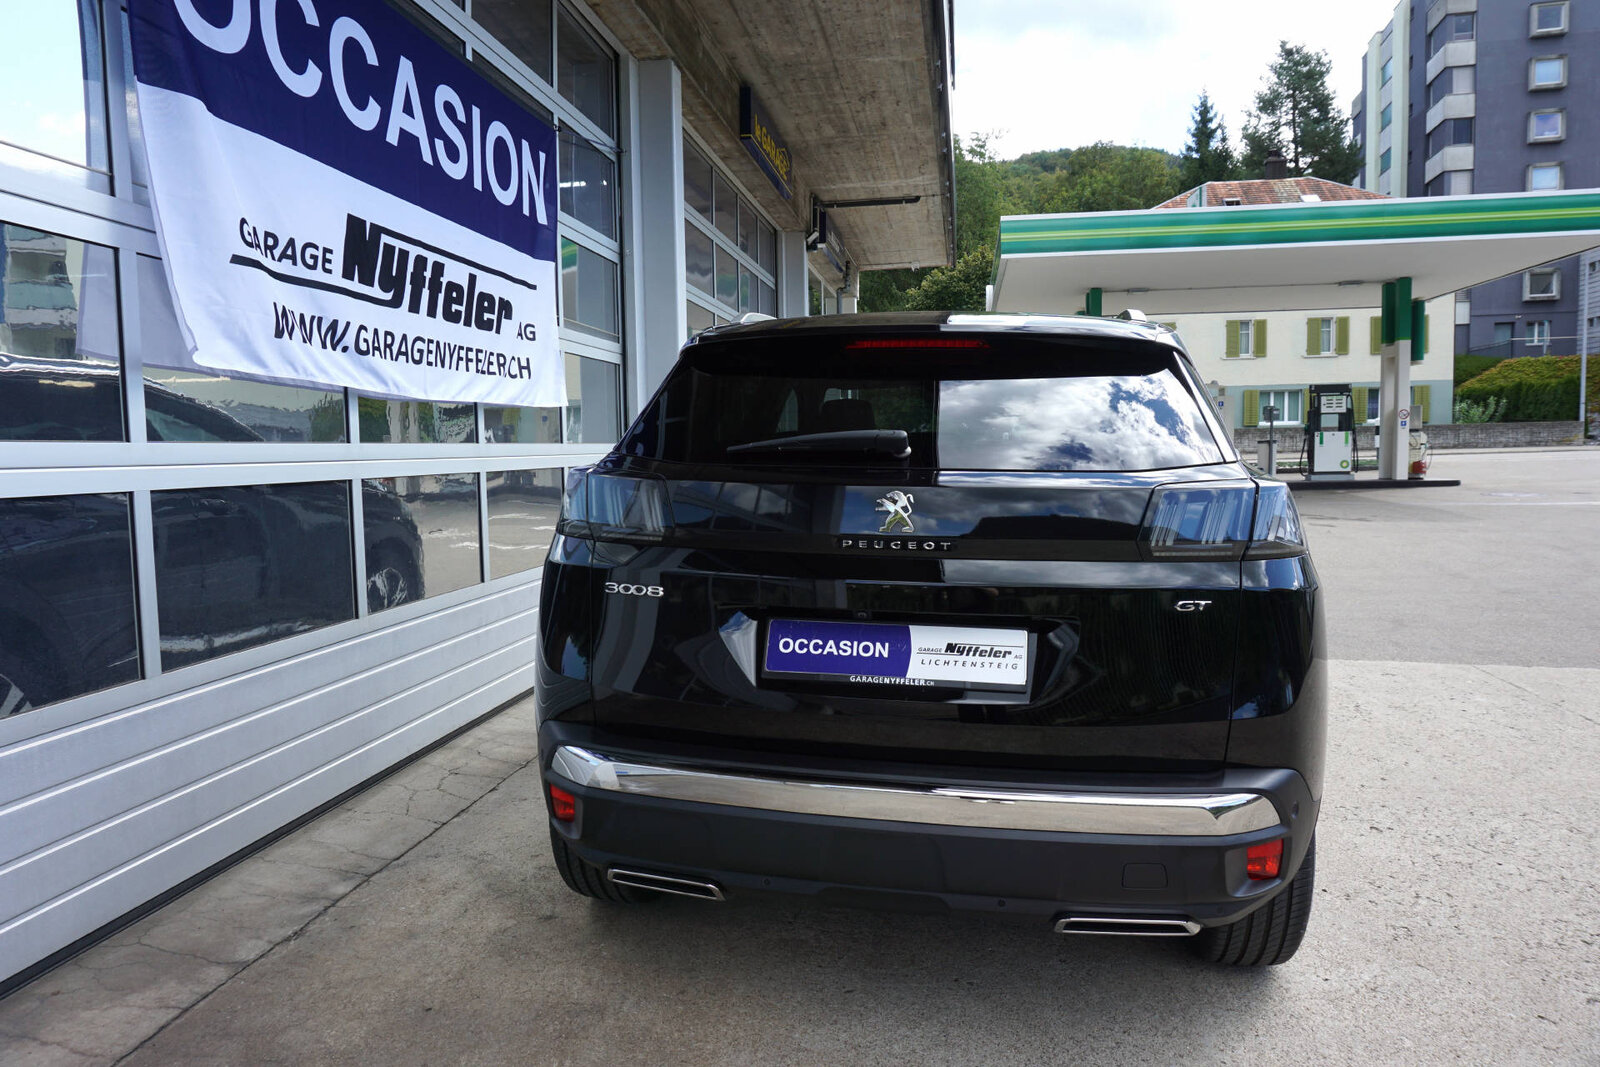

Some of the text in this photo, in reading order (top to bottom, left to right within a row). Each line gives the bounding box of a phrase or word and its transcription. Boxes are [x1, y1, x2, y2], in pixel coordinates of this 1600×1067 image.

[239, 213, 536, 341] GARAGE Nyffeler AG
[842, 539, 951, 551] PEUGEOT
[604, 582, 665, 597] 3008
[1174, 600, 1213, 612] GT
[778, 638, 889, 658] OCCASION
[944, 642, 1012, 659] Nyffeler
[920, 658, 1019, 670] LICHTENSTEIG
[849, 675, 935, 687] GARAGENYFFELER.CH
